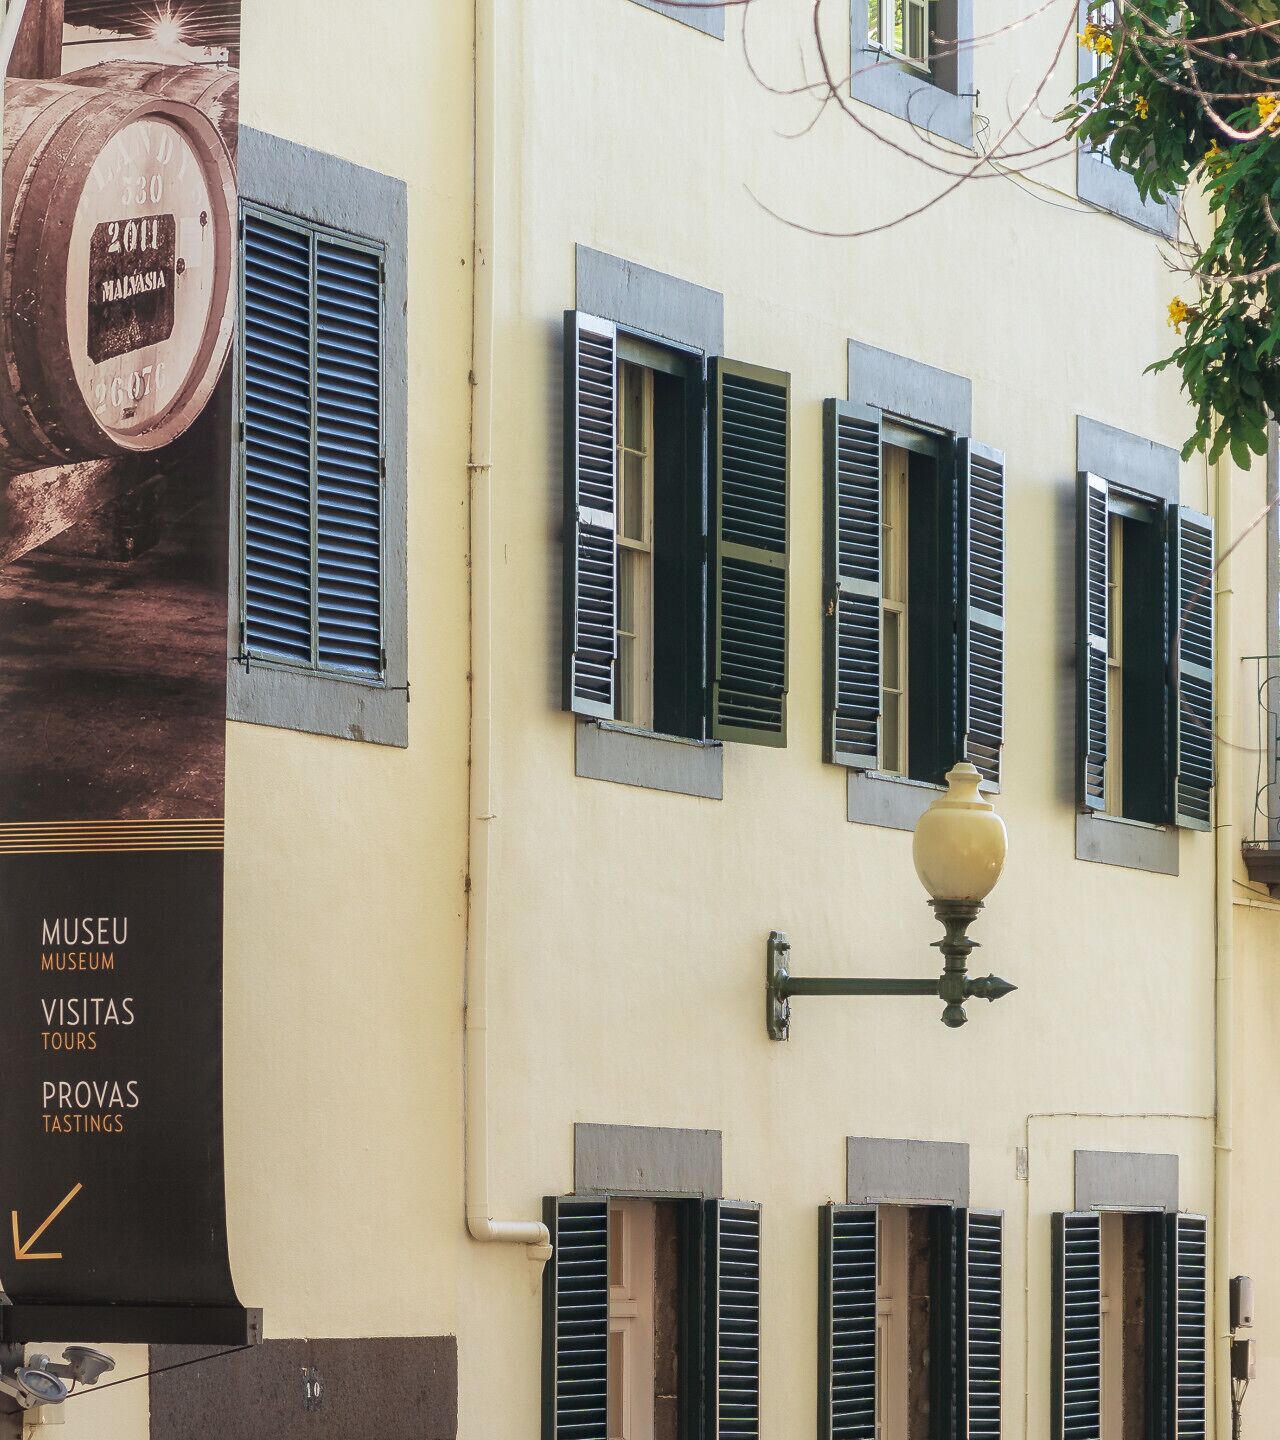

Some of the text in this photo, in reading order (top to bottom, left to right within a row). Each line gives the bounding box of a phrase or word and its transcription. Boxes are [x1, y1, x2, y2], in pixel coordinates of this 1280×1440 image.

[106, 218, 159, 254] 2011
[41, 917, 129, 946] MUSEU
[41, 951, 115, 971] MUSEUM
[41, 997, 135, 1026] VISITAS
[41, 1031, 98, 1051] TOURS
[42, 1080, 140, 1109] PROVAS
[42, 1113, 124, 1133] TASTINGS
